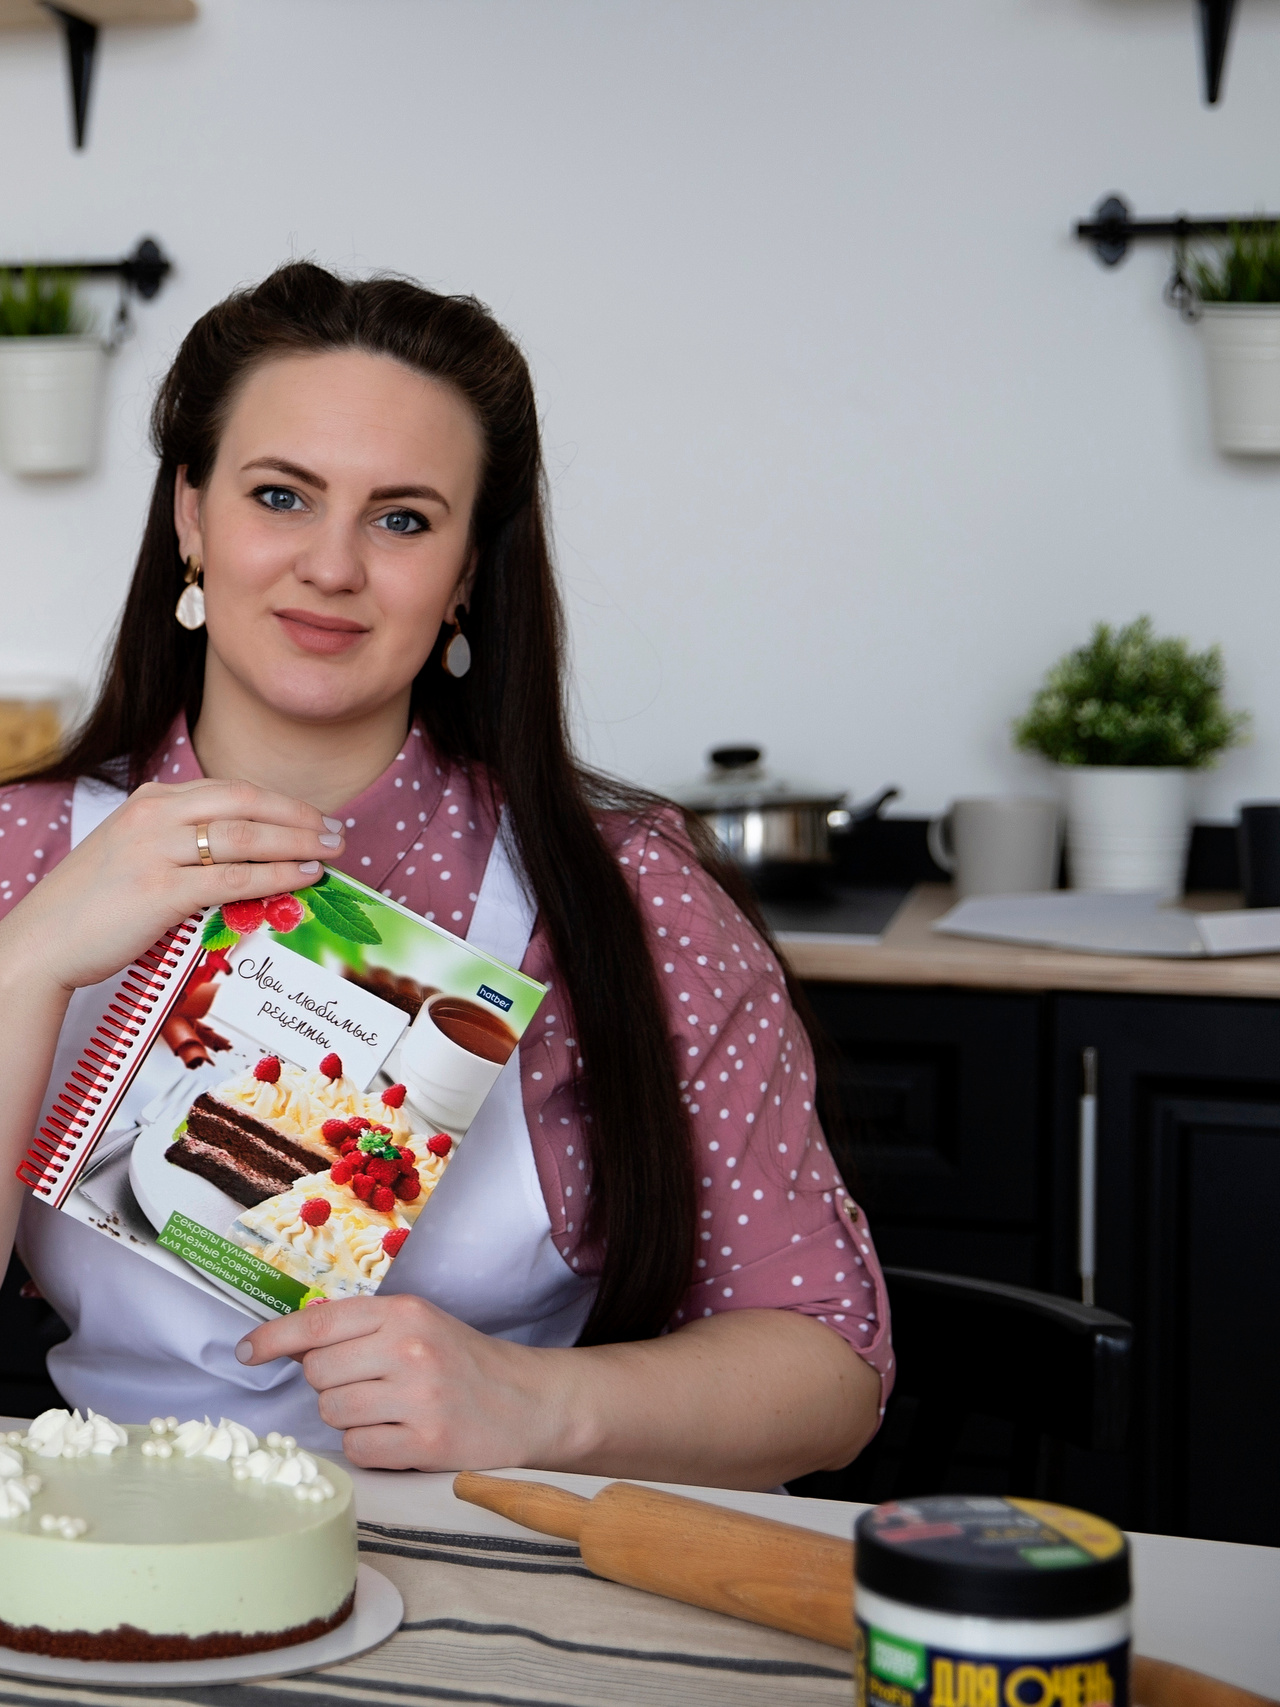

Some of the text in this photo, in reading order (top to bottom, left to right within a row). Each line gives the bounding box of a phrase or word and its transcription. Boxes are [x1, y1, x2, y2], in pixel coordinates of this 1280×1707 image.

[237, 956, 378, 1046] Мои любимые
[256, 1000, 332, 1049] рецепты
[479, 987, 510, 1009] hatber
[159, 1235, 293, 1315] для семейных торжеств
[166, 1223, 261, 1282] полезные советы
[220, 1241, 282, 1280] кулинарии
